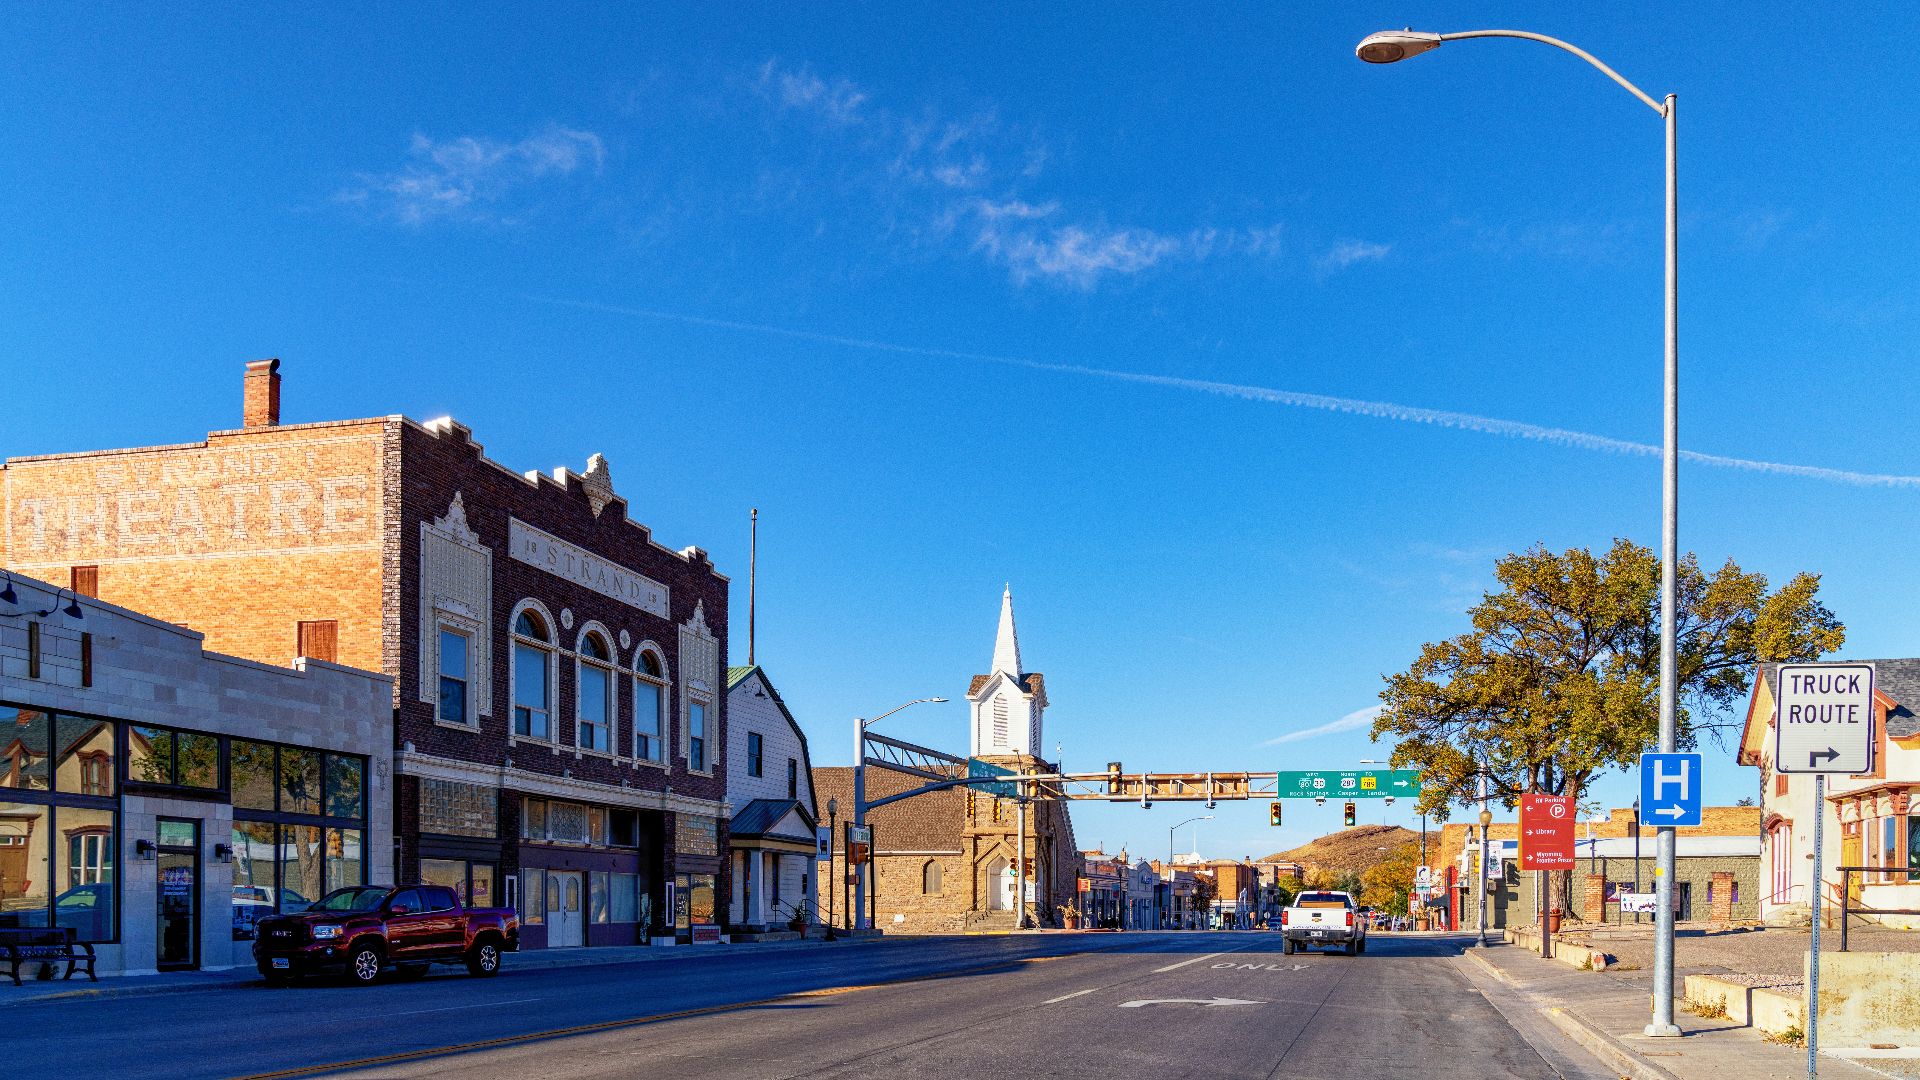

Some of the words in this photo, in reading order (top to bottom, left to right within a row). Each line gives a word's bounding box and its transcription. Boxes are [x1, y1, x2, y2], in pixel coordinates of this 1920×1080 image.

[18, 474, 369, 550] THEATRE
[547, 545, 641, 600] STRAND
[1791, 674, 1861, 695] TRUCK
[1789, 704, 1860, 724] ROUTE
[1653, 759, 1689, 801] H
[1535, 828, 1556, 836] Library
[1210, 962, 1310, 971] ONLY
